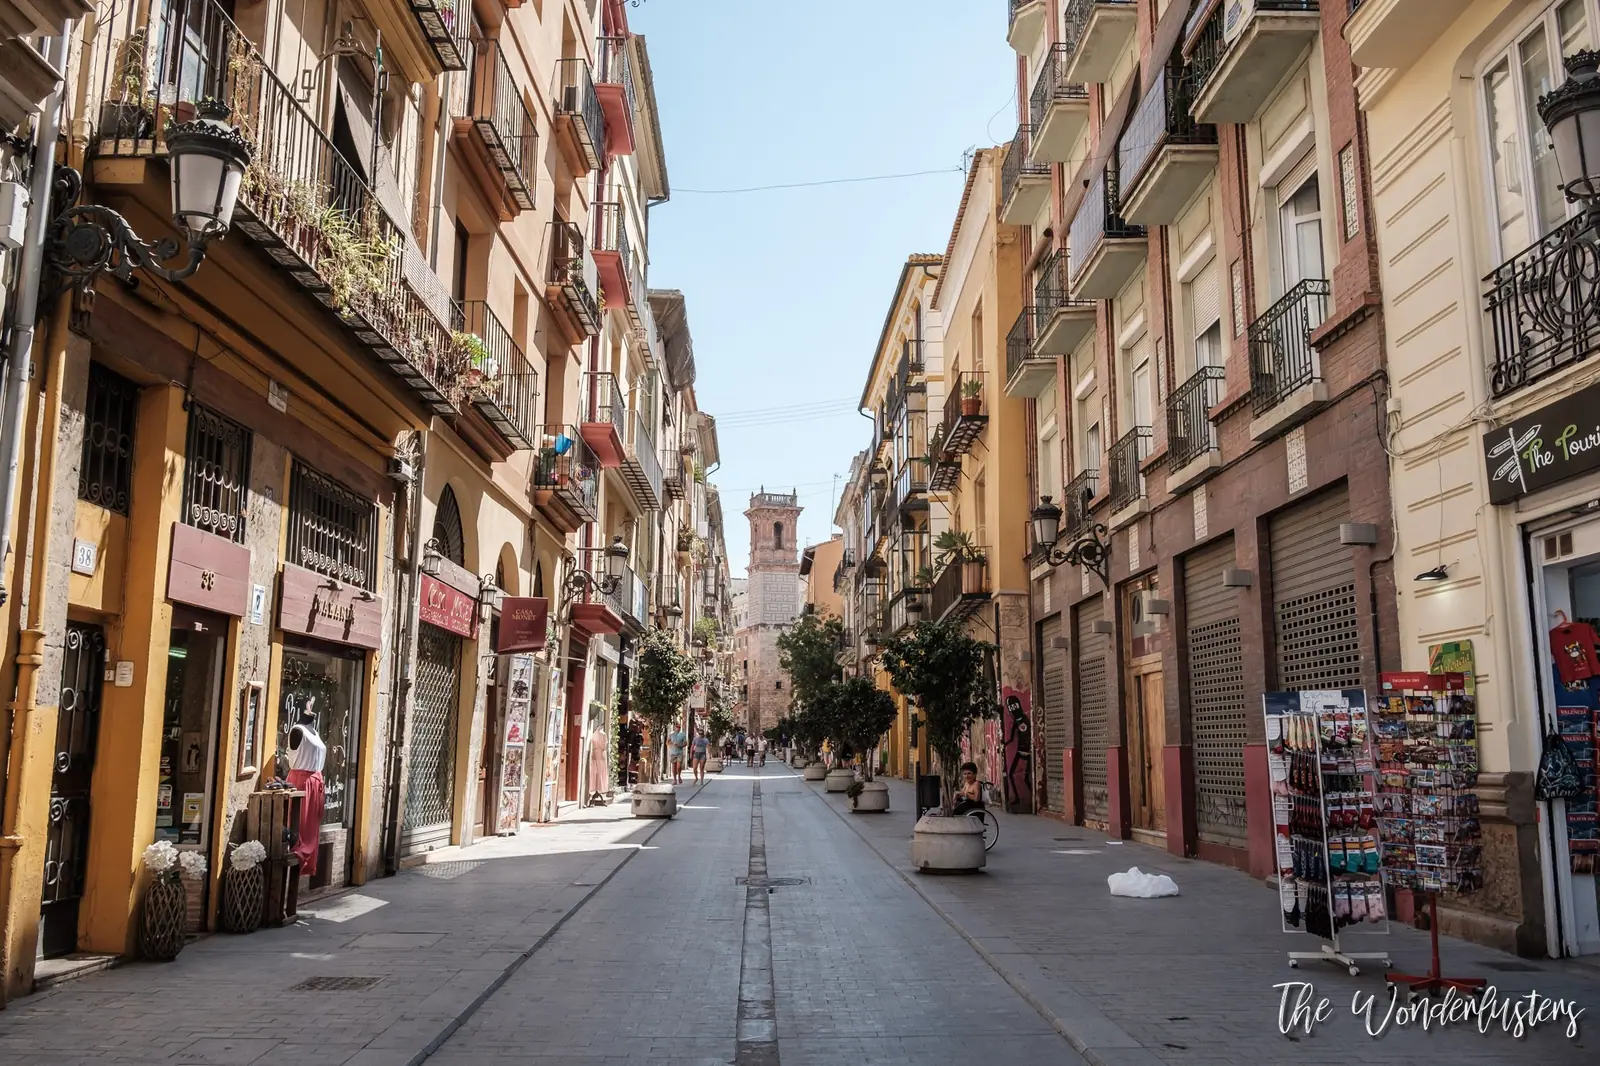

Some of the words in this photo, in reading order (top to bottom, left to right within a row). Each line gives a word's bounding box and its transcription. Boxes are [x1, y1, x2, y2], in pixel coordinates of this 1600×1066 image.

[1523, 438, 1554, 473] The
[79, 547, 91, 566] 38
[201, 569, 215, 588] 38
